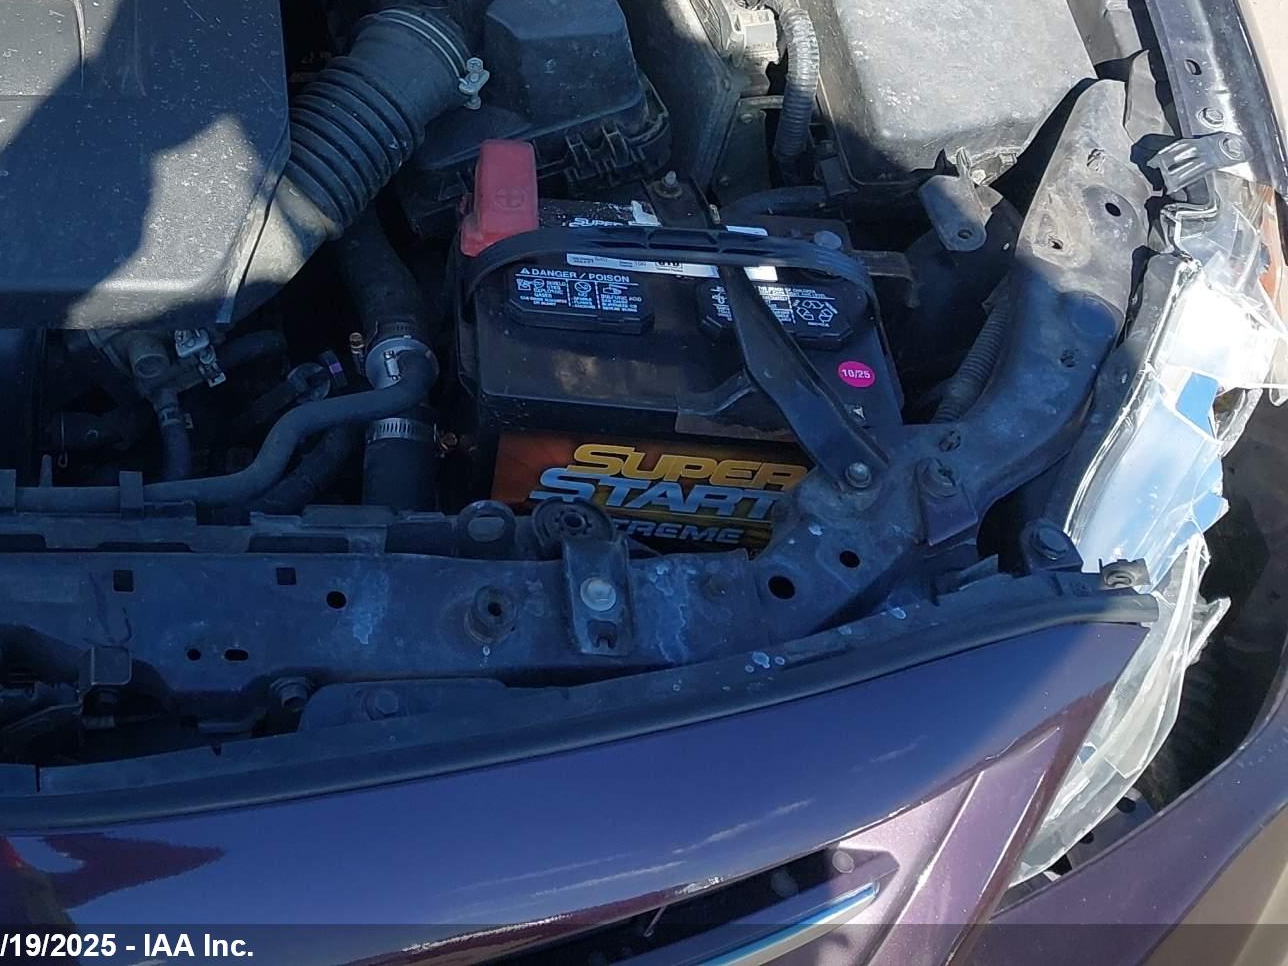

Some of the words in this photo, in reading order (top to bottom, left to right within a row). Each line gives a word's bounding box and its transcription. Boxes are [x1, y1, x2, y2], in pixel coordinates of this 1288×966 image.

[531, 268, 577, 279] DANGER
[588, 273, 630, 283] POISON
[841, 369, 871, 379] 10/25
[567, 443, 807, 491] SUPER
[528, 467, 779, 520] START
